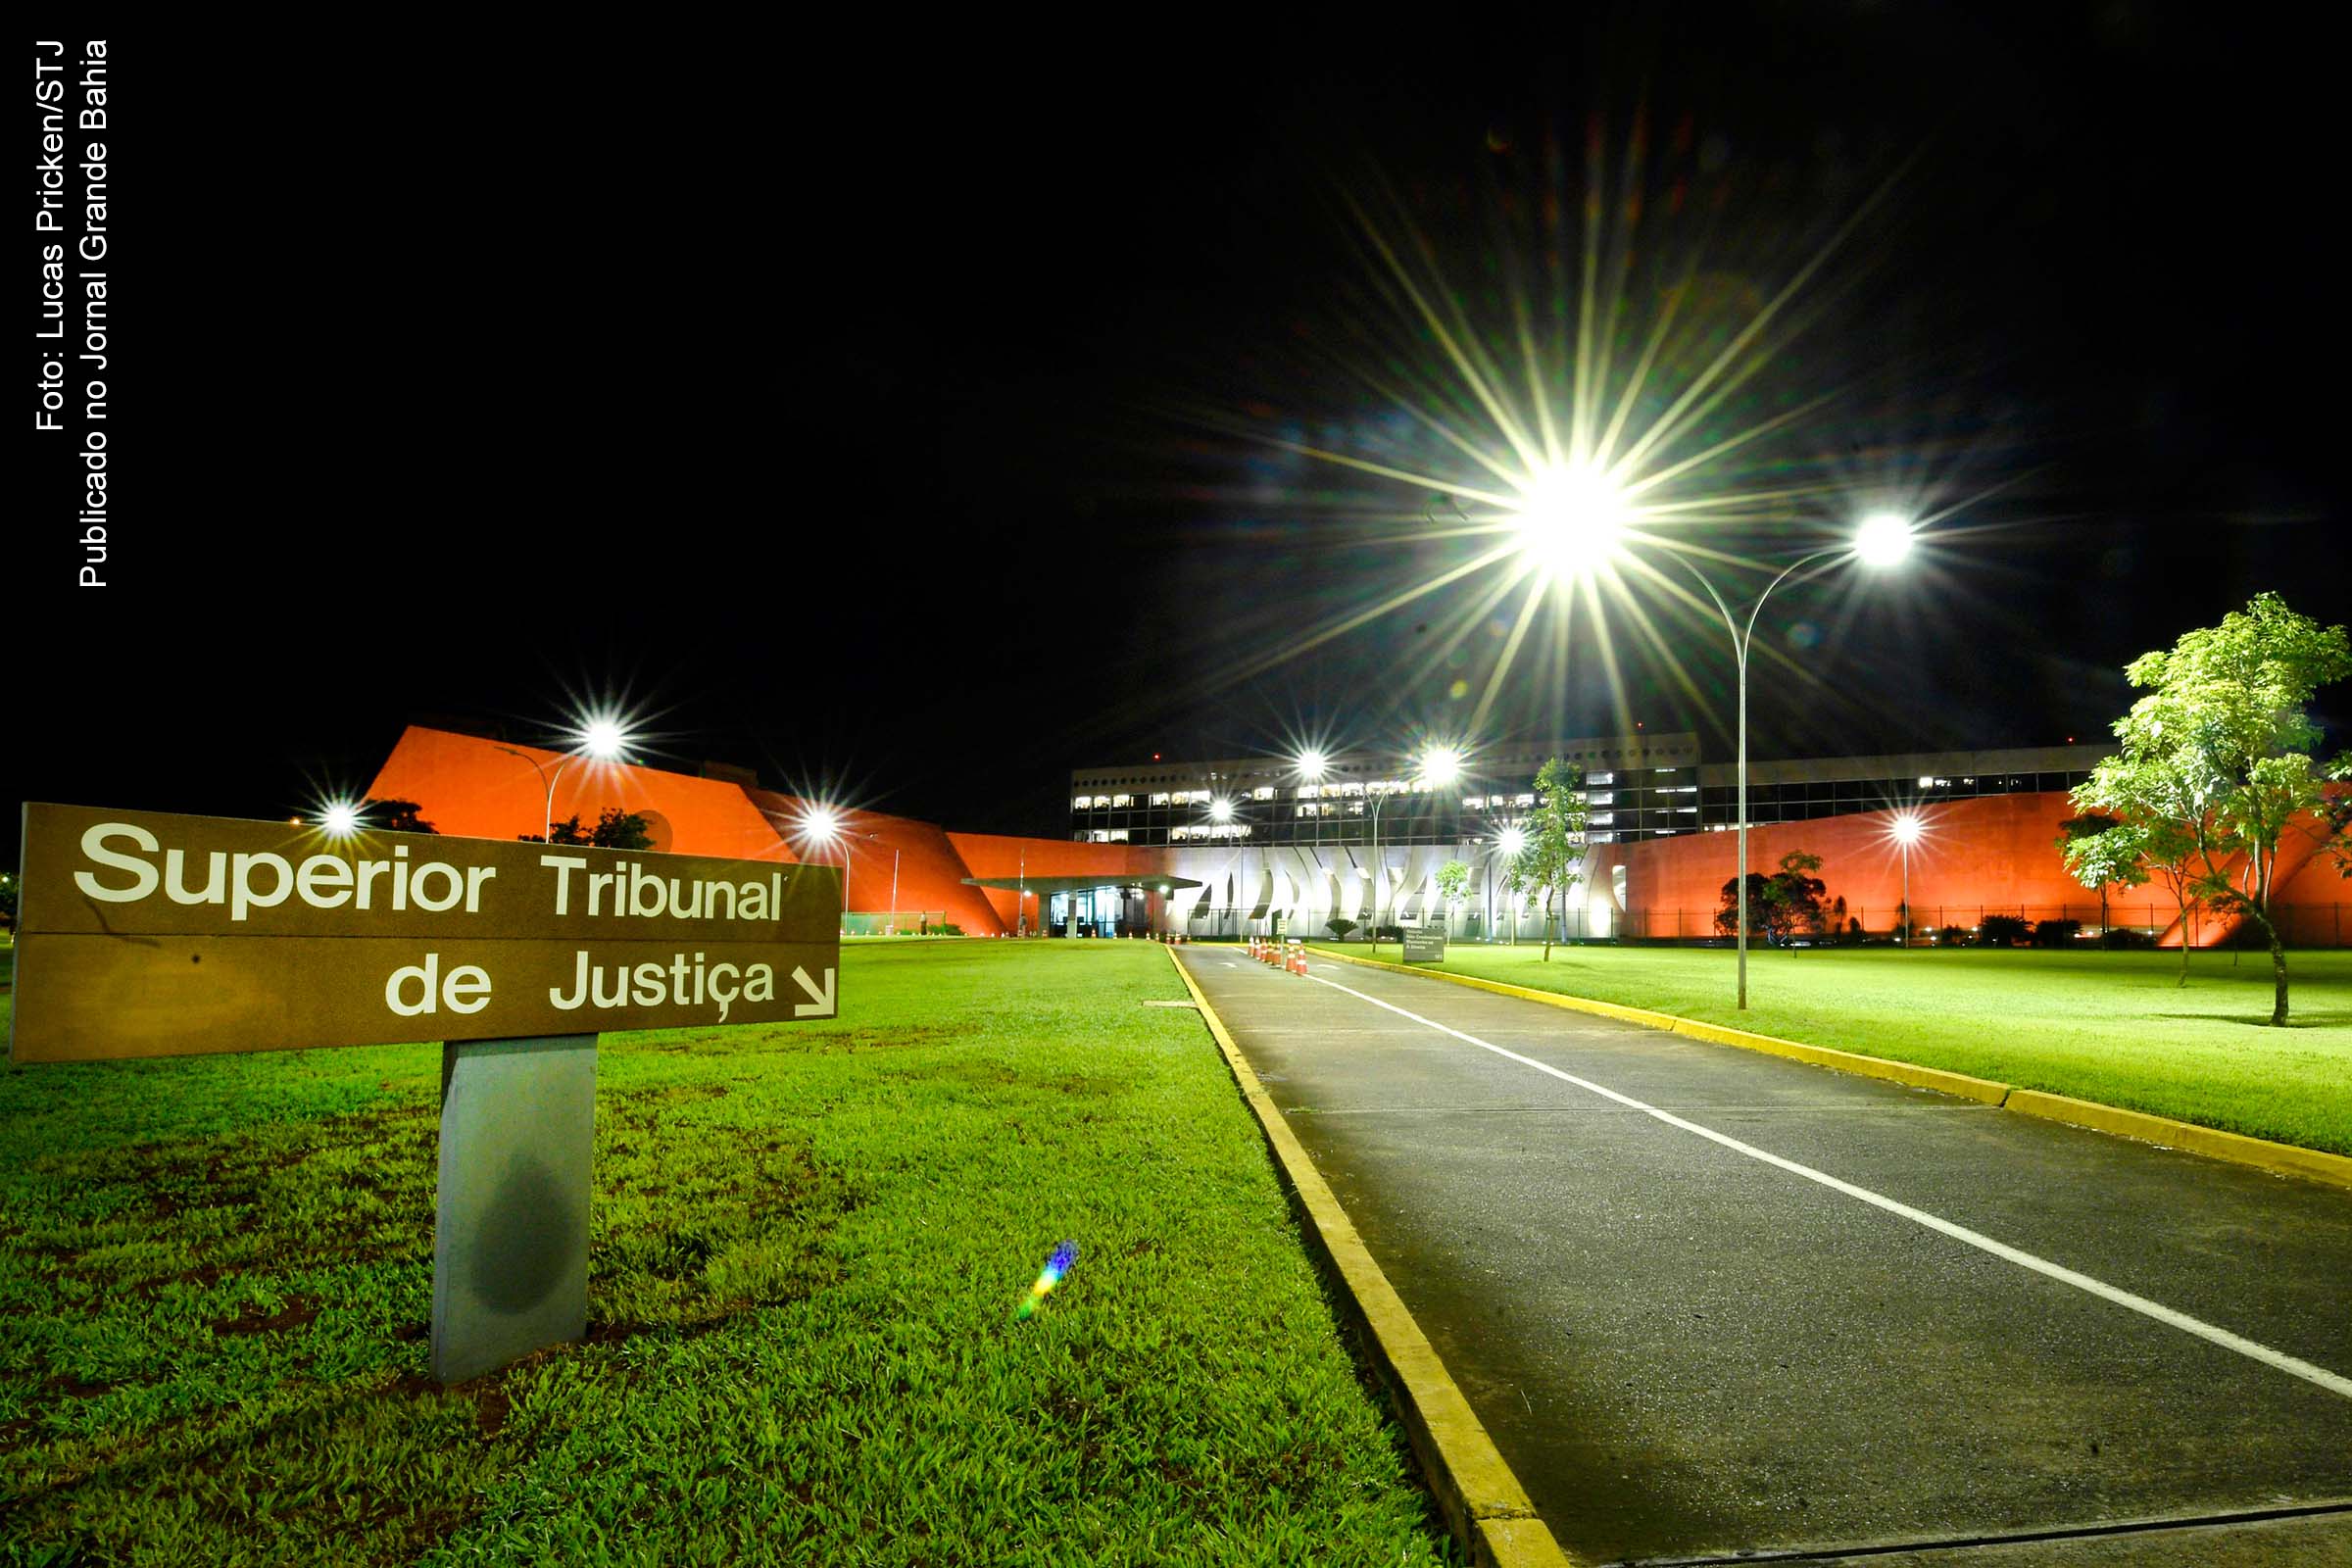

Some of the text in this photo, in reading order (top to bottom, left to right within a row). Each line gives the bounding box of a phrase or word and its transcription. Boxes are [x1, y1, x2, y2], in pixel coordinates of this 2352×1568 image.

[74, 822, 782, 921] Superior Tribunal
[385, 951, 774, 1023] de Justiça
